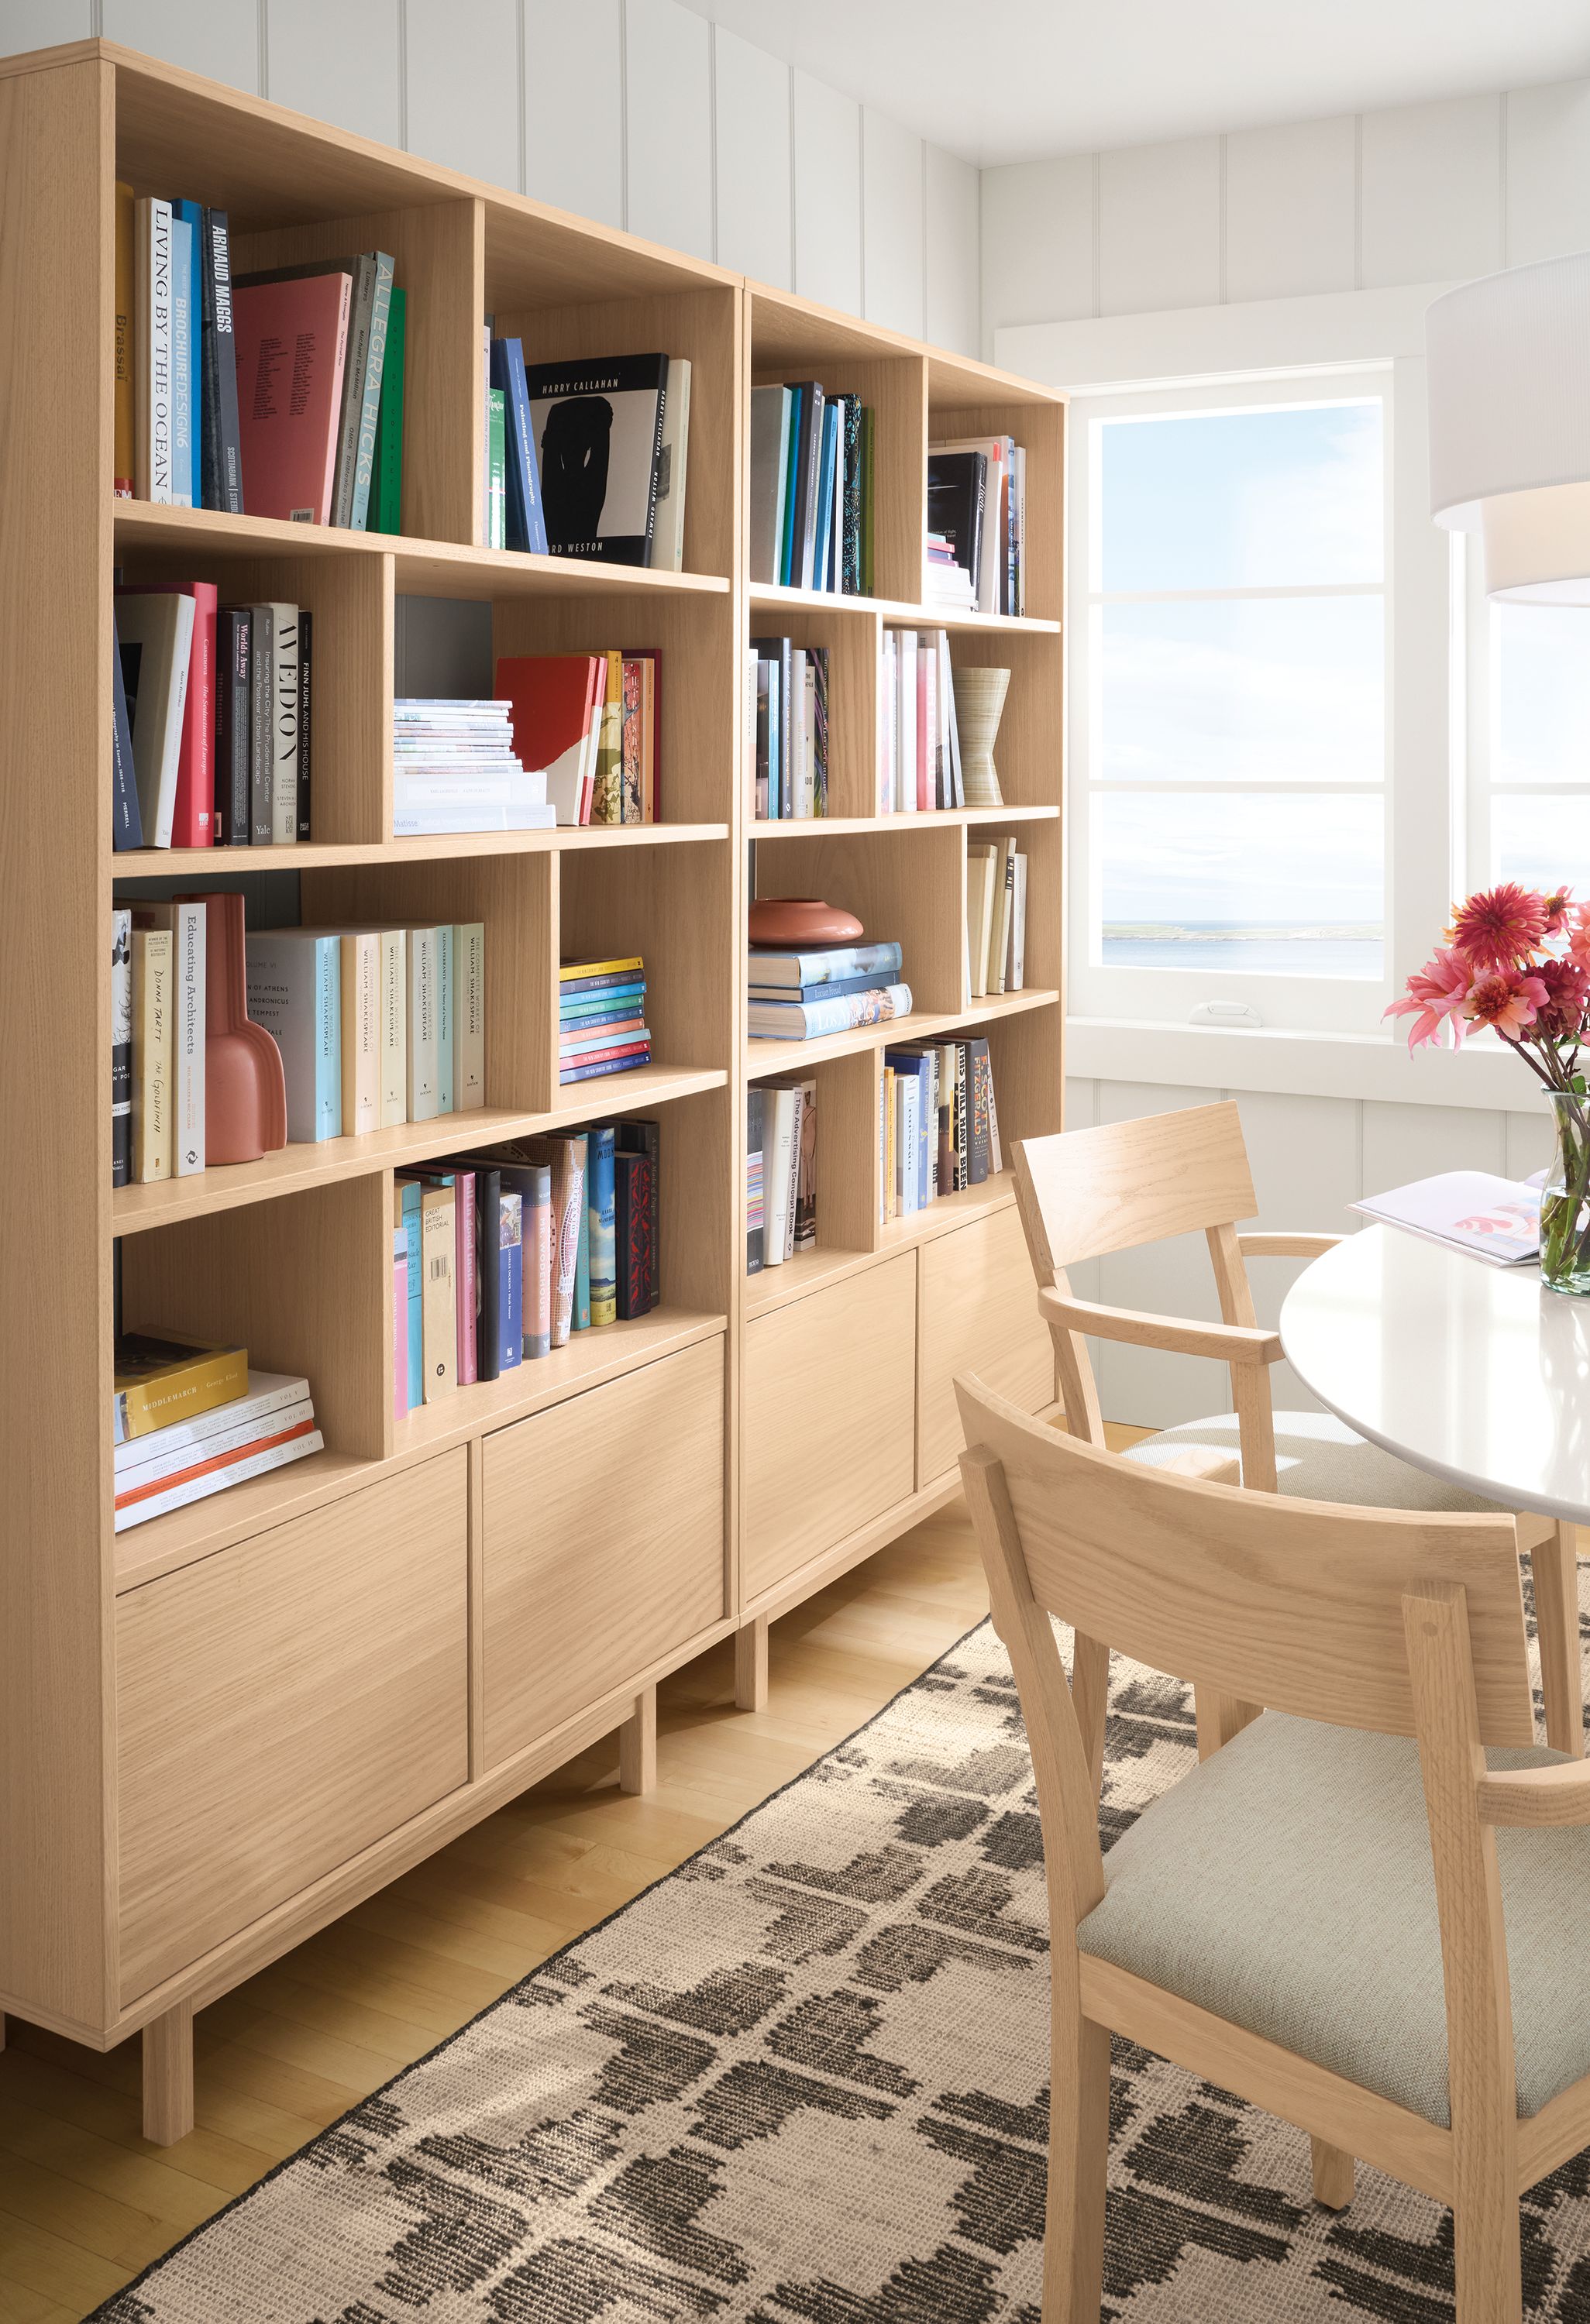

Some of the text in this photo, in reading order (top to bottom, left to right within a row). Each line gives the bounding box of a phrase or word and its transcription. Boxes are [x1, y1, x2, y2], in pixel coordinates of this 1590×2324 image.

[212, 225, 232, 333] ARNAUD MAGGS
[116, 315, 127, 382] Brassaï
[155, 209, 168, 489] LIVING BY THE OCEAN
[358, 263, 393, 487] ALLEGRA HICKS
[542, 378, 619, 394] HARRY CALLAHAN
[656, 418, 664, 457] CALLAHAN
[227, 446, 236, 486] SCOTIABANK
[526, 456, 535, 506] Photography
[239, 656, 247, 679] Away
[278, 617, 297, 761] AVEDON
[256, 825, 270, 835] Yale
[394, 819, 418, 828] Matisse
[154, 971, 165, 1002] DONNA
[185, 916, 197, 1055] Educating Architects
[814, 984, 841, 999] Lucian Freud
[154, 1008, 163, 1043] TARTT
[817, 1010, 837, 1031] Los
[980, 1055, 987, 1070] F.
[597, 1148, 614, 1160] MOON
[790, 1116, 800, 1170] Advertising
[425, 1207, 441, 1218] GREAT
[425, 1215, 443, 1225] BRITISH
[425, 1220, 449, 1233] EDITORIAL
[206, 1379, 225, 1388] George
[142, 1386, 197, 1412] MIDDLEMARCH
